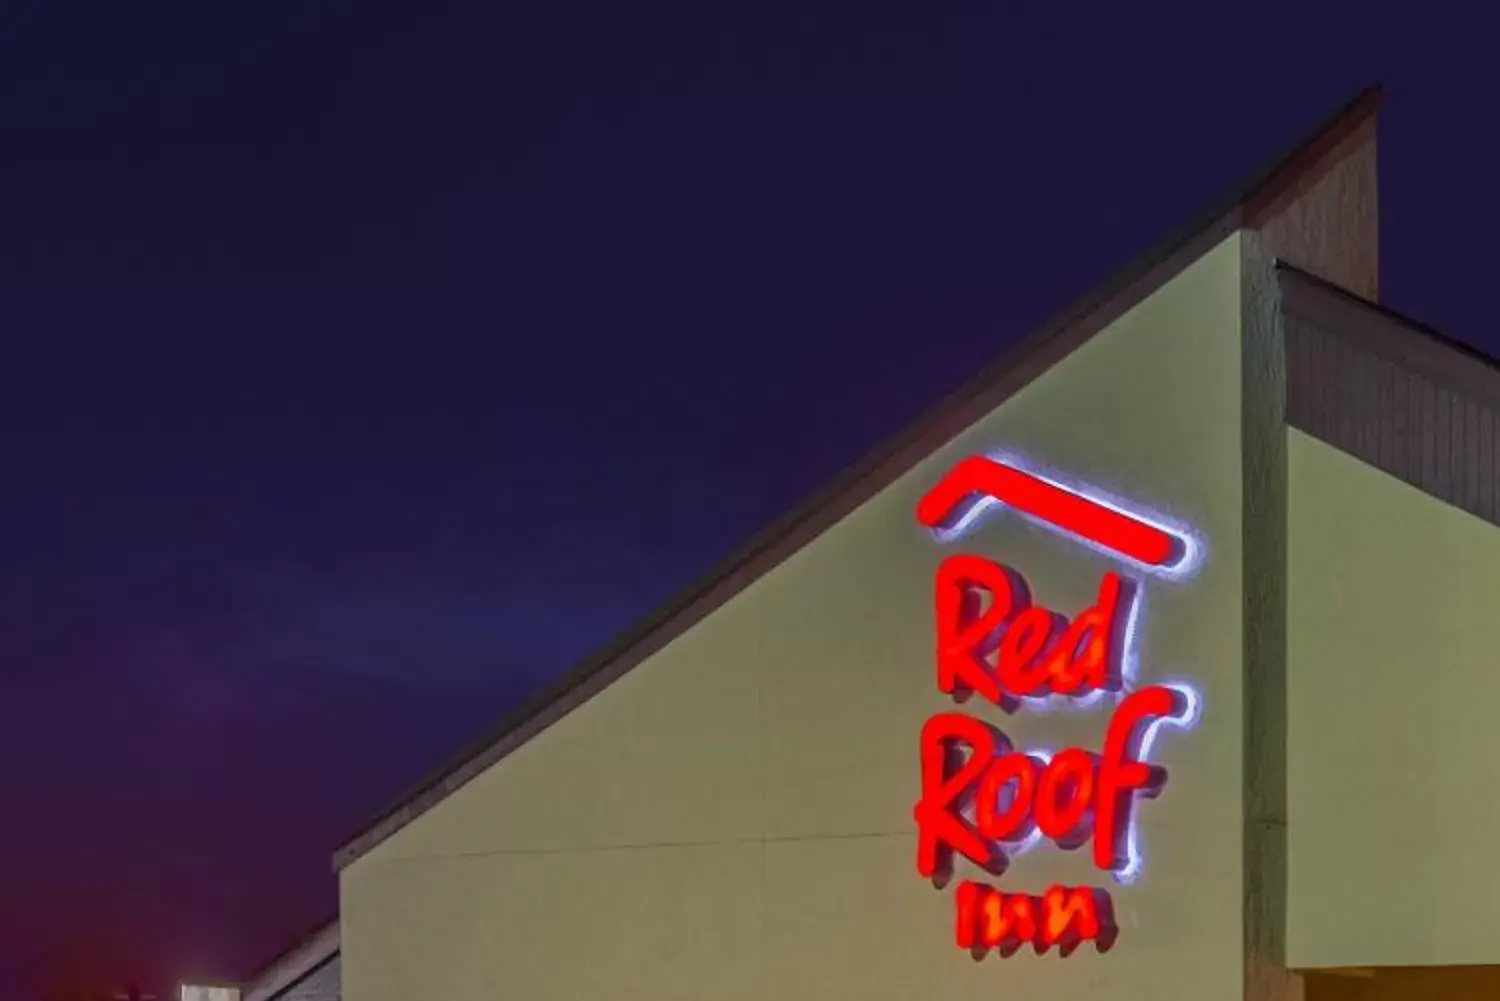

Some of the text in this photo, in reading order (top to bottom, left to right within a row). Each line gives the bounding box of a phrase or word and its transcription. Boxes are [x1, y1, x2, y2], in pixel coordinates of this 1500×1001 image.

[935, 554, 1120, 703] Red
[914, 685, 1173, 877] Roof
[954, 879, 1100, 950] Inn
